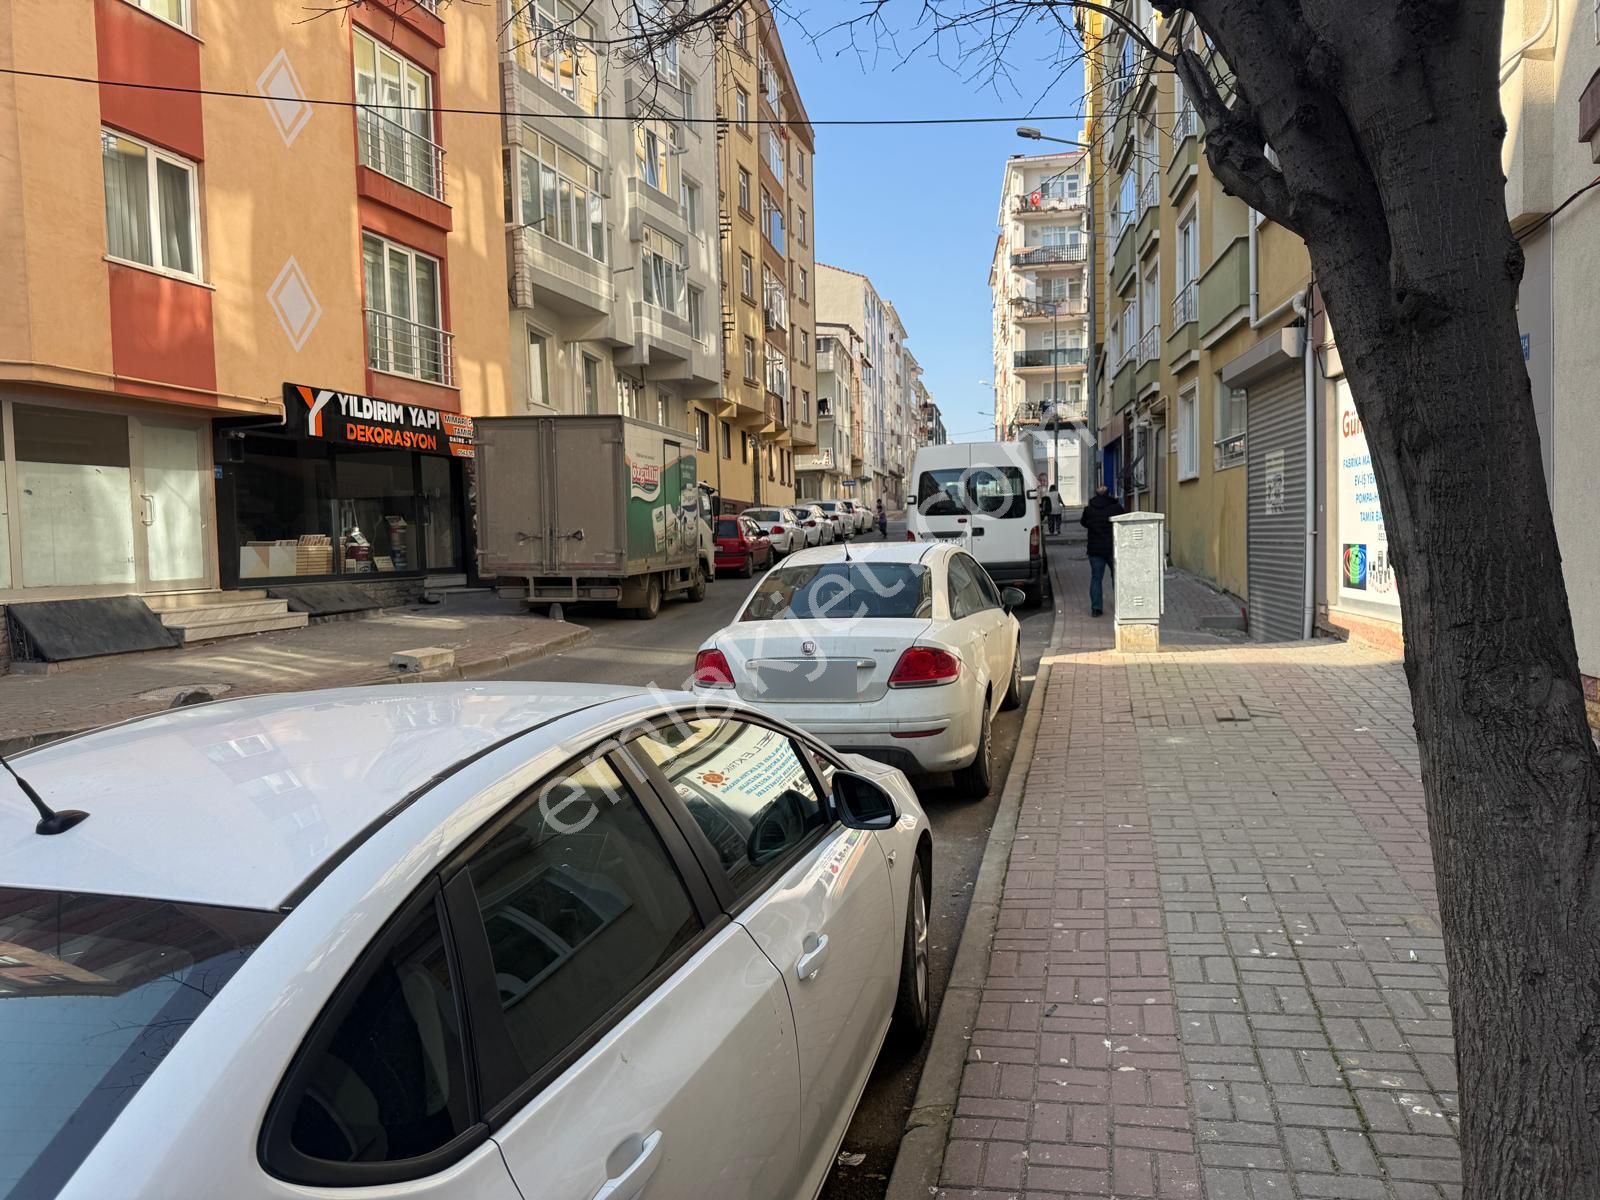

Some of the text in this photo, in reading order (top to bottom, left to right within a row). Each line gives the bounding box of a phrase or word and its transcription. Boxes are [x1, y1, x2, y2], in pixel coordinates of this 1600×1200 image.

[336, 393, 441, 430] YILDIRIM YAPI
[346, 423, 437, 450] DEKORASYON
